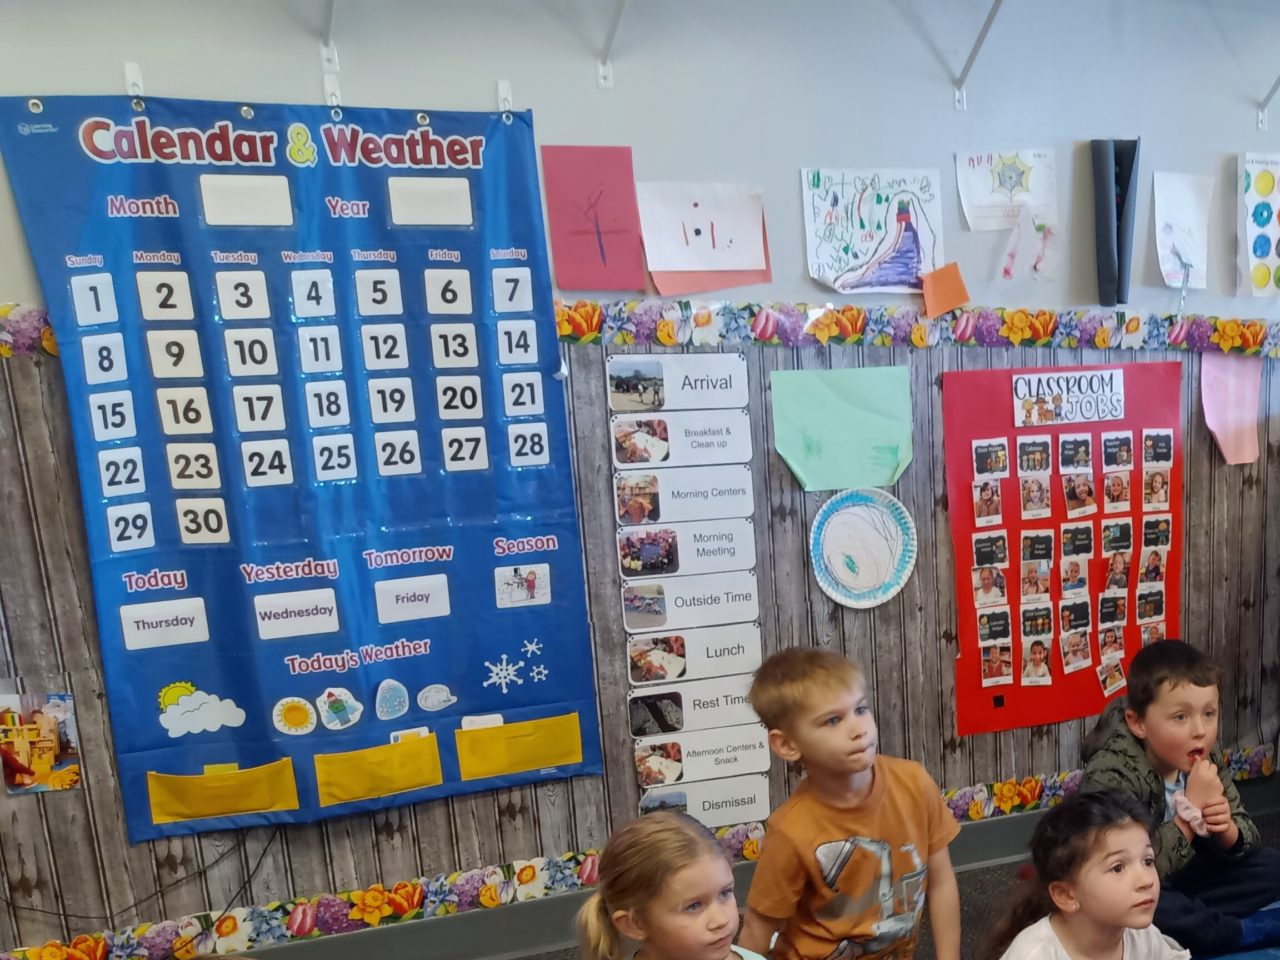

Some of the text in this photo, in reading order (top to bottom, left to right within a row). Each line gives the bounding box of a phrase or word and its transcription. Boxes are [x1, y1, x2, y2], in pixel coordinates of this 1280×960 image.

[79, 117, 484, 168] Calendar & Weather
[108, 195, 179, 217] Month
[326, 197, 369, 218] Year
[67, 255, 103, 267] Sunday
[133, 252, 180, 265] Monday
[212, 251, 257, 264] Tuesday
[282, 251, 333, 263] Wednesday
[352, 250, 395, 262] Thursday
[429, 249, 460, 262] Friday
[89, 278, 520, 312] 1 2 3 4 5 6 7
[98, 330, 530, 372] 8 9 10 11 12 13 14
[681, 374, 733, 391] Arrival
[1014, 372, 1113, 400] CLASSROOM
[97, 382, 536, 430] 15 16 17 18 19 20 21
[1065, 392, 1122, 420] JOBS
[684, 427, 731, 438] Breakfast &
[690, 439, 727, 450] Clean up
[105, 433, 544, 487] 22 23 24 25 26 27 28
[671, 487, 746, 500] Morning Centers
[114, 509, 223, 541] 29 30
[494, 535, 558, 556] Season
[693, 533, 733, 545] Morning
[364, 546, 453, 568] Tomorrow
[696, 545, 736, 558] Meeting
[241, 558, 338, 583] Yesterday
[123, 570, 187, 592] Today
[395, 592, 430, 604] Friday
[674, 592, 752, 608] Outside Time
[259, 605, 334, 622] Wednesday
[134, 616, 195, 631] Thursday
[286, 638, 431, 674] Today's Weather
[706, 643, 745, 659] Lunch
[693, 698, 720, 710] Rest
[686, 741, 764, 758] Afternoon Centers &
[714, 756, 738, 766] Snack
[702, 794, 756, 812] Dismissal
